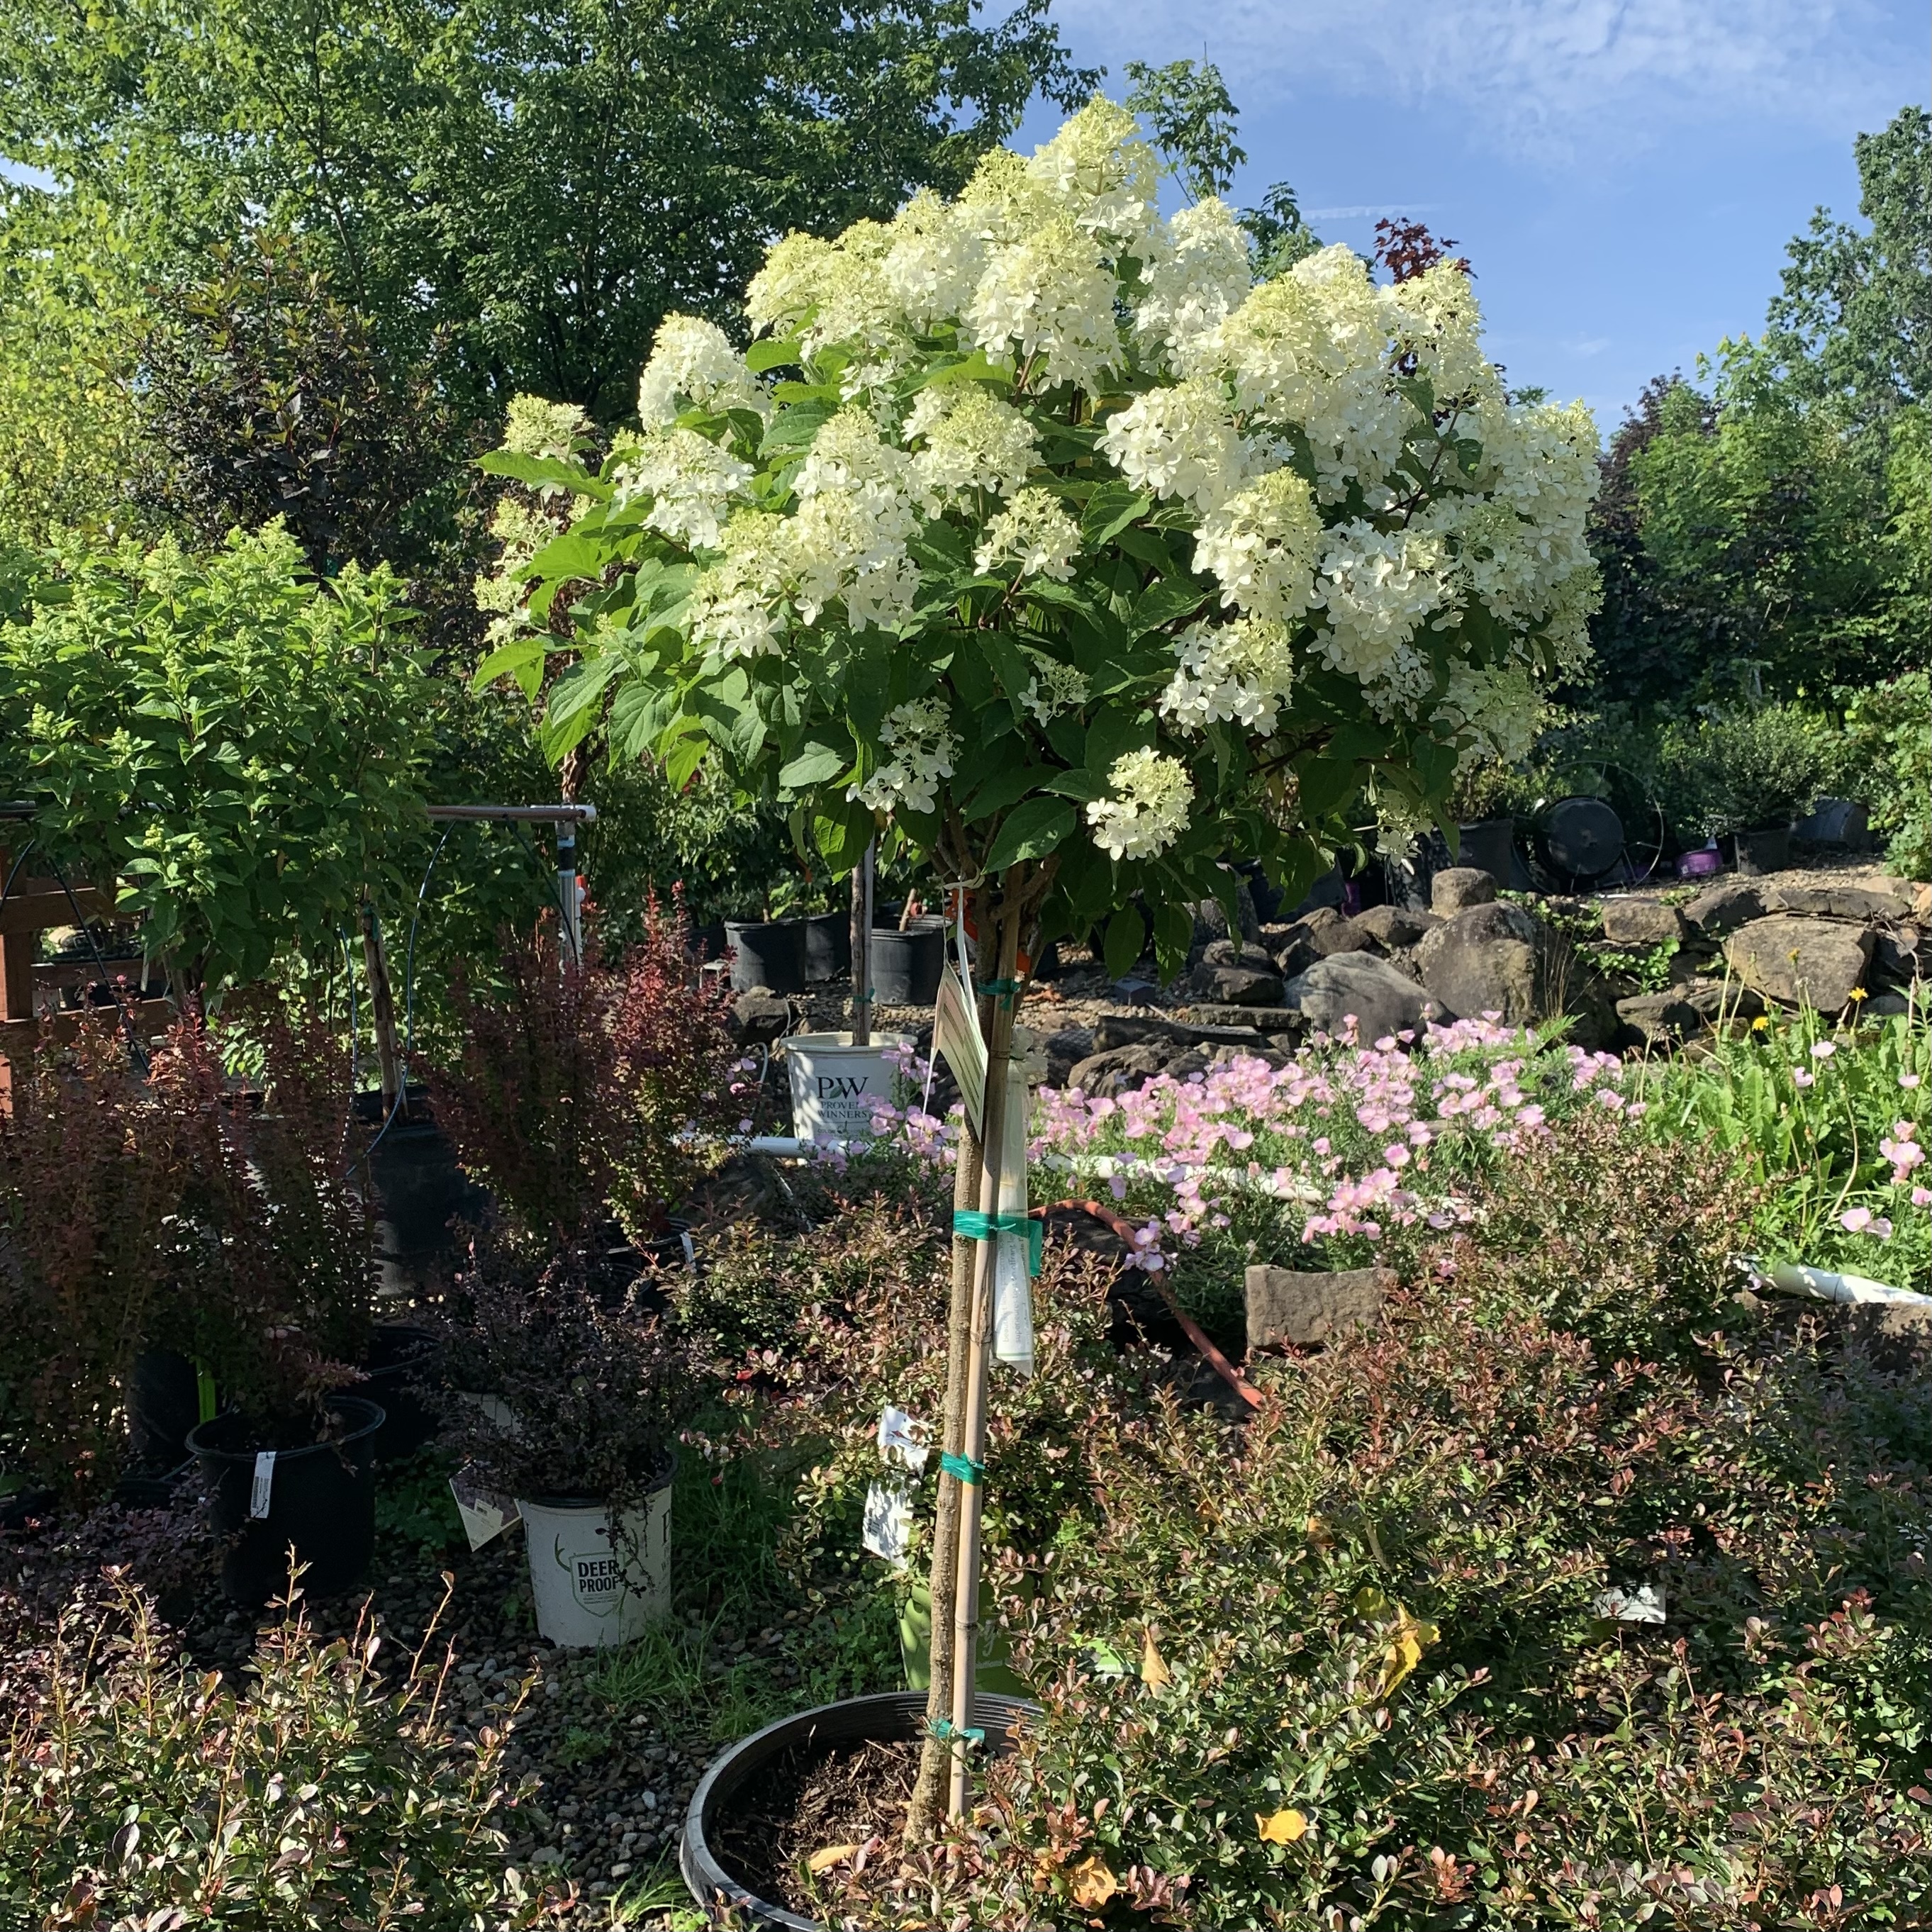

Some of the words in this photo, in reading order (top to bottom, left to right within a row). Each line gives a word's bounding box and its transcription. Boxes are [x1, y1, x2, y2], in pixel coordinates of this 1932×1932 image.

[816, 1076, 869, 1100] PW
[817, 1110, 867, 1118] WINNERS
[577, 1559, 618, 1578] DEER
[579, 1575, 619, 1592] PROOF
